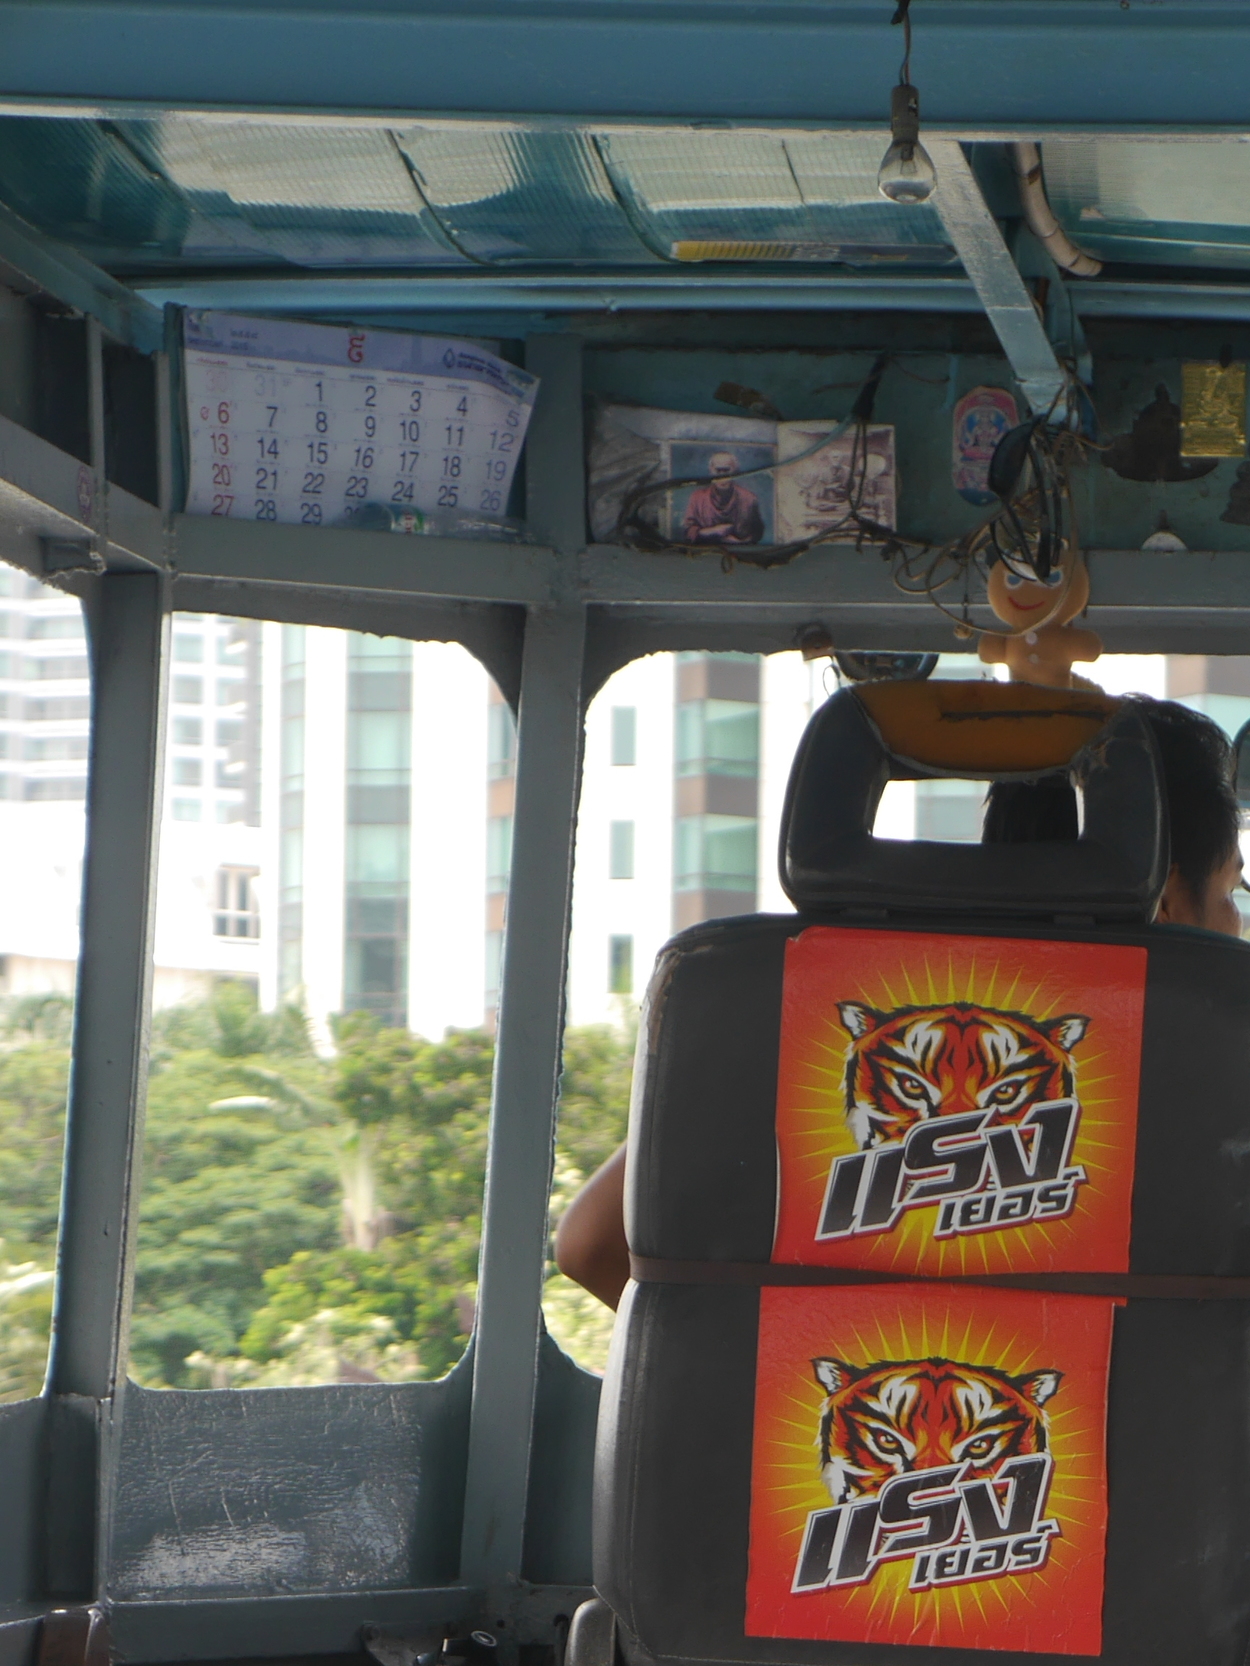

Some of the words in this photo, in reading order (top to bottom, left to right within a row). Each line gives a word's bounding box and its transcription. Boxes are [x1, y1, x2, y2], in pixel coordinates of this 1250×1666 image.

[217, 401, 230, 424] 6
[265, 405, 278, 428] 7
[315, 411, 328, 433] 8
[365, 415, 376, 438] 9
[399, 420, 420, 443] 10
[445, 424, 465, 447] 11
[489, 430, 514, 453] 12
[254, 374, 277, 398] 31
[314, 381, 323, 402] 1
[364, 385, 377, 407] 2
[410, 390, 422, 412] 3
[456, 396, 468, 417] 4
[506, 410, 520, 428] 5
[210, 433, 229, 456] 13
[257, 437, 279, 460] 14
[307, 442, 328, 465] 15
[354, 447, 374, 469] 16
[399, 451, 420, 473] 17
[442, 455, 461, 478] 18
[486, 459, 506, 482] 19
[210, 494, 235, 517] 27
[254, 499, 277, 521] 28
[300, 503, 322, 526] 29
[212, 463, 231, 487] 20
[255, 468, 278, 491] 21
[302, 472, 325, 495] 22
[344, 476, 369, 498] 23
[391, 480, 414, 502] 24
[437, 485, 458, 507] 25
[480, 489, 501, 511] 26
[815, 1098, 1083, 1243] แรง
[934, 1166, 1086, 1241] เยอร์
[790, 1452, 1055, 1594] แรง
[908, 1519, 1060, 1591] เยอร์
